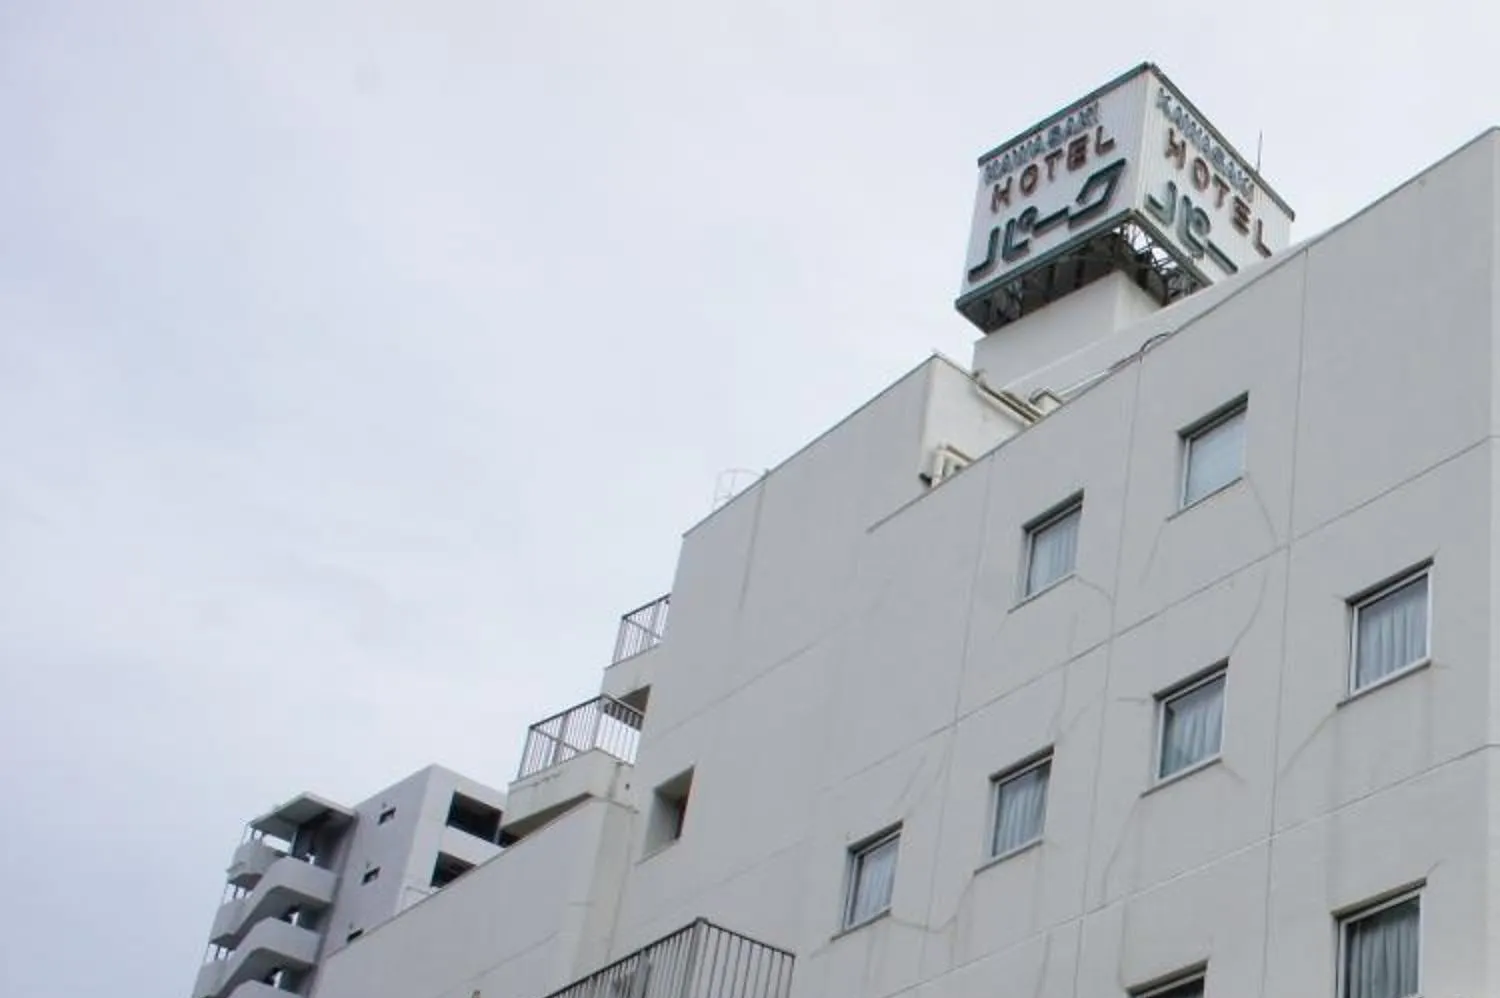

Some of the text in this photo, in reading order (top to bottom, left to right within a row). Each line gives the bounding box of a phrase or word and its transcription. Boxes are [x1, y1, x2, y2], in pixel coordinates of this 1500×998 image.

[968, 157, 1127, 283] パーク
[991, 125, 1116, 214] HOTEL
[1165, 127, 1273, 258] HOTEL
[1144, 179, 1239, 275] パー
